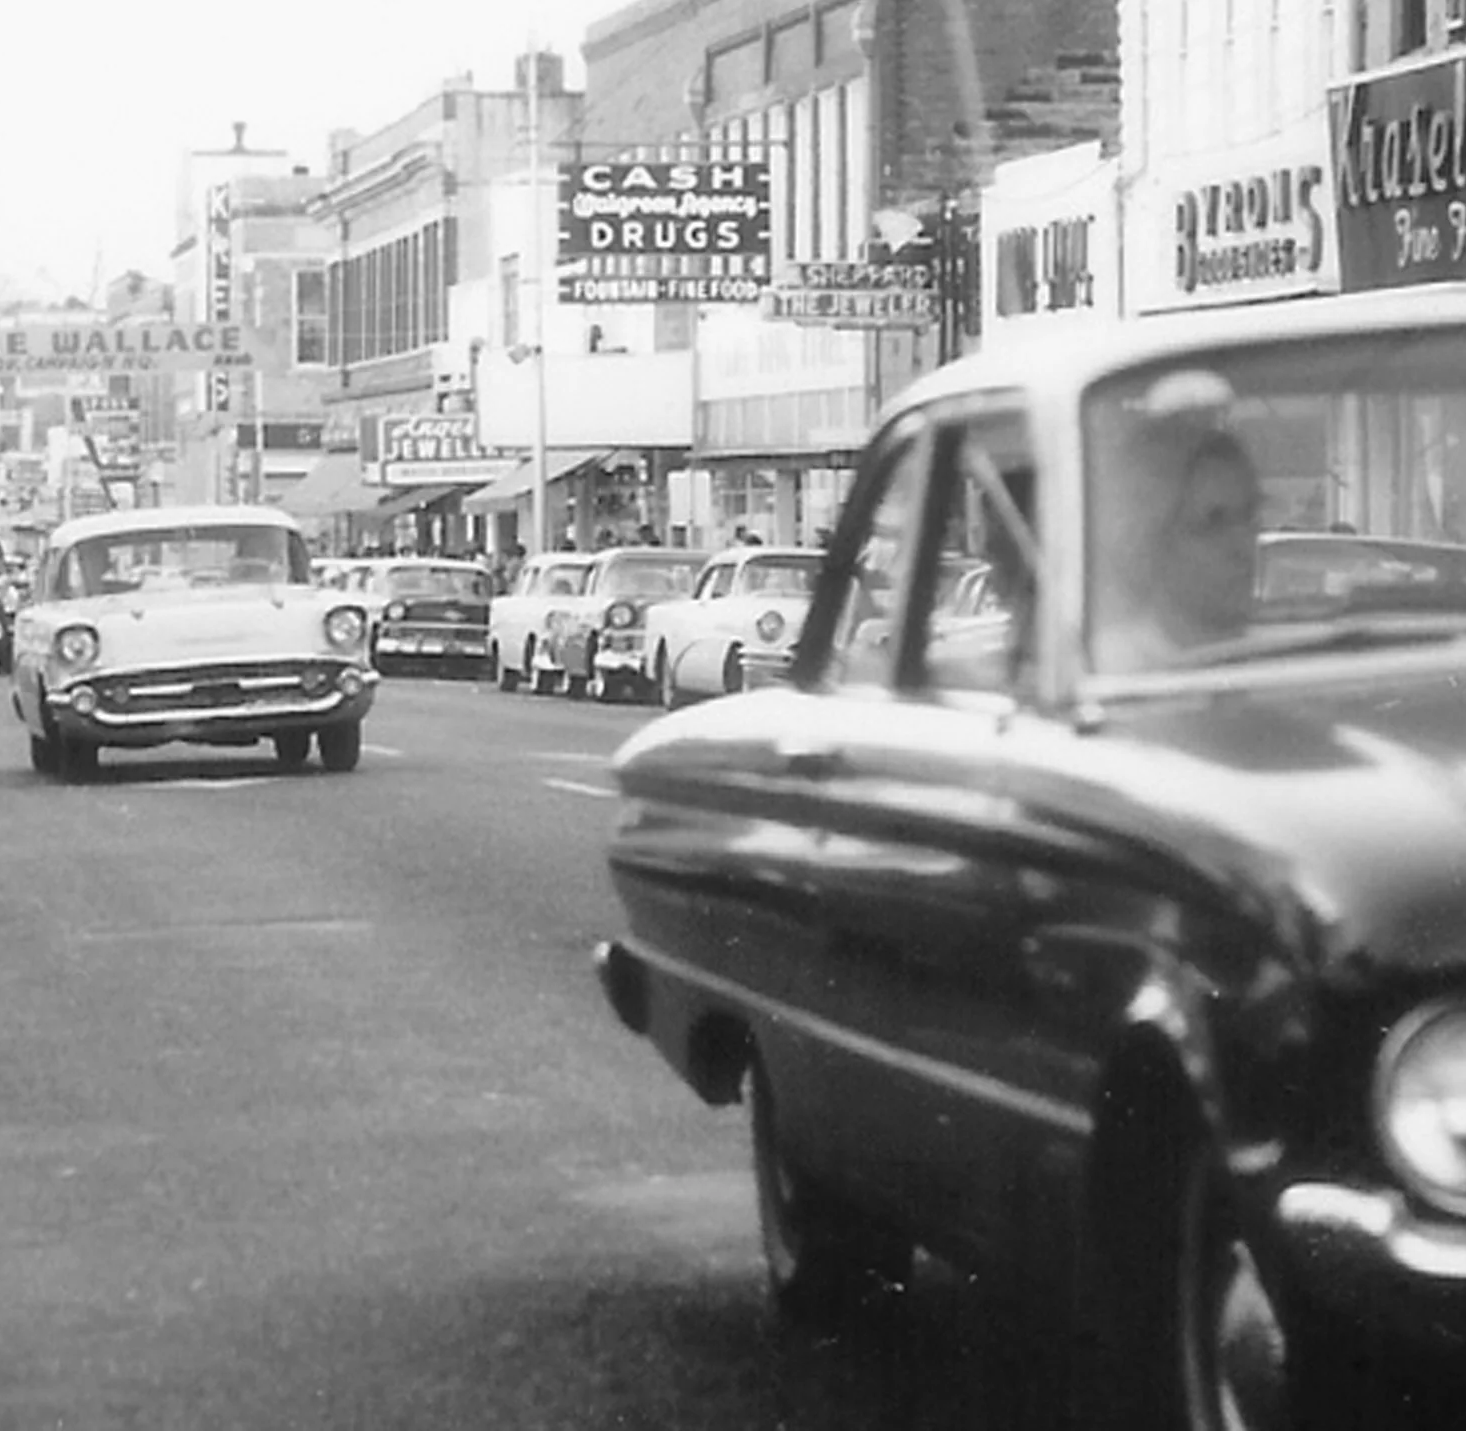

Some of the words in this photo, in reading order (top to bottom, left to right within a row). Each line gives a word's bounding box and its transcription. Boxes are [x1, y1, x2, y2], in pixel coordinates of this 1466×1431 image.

[582, 165, 744, 190] CASH
[590, 220, 741, 250] DRUGS
[51, 325, 242, 355] WALLACE
